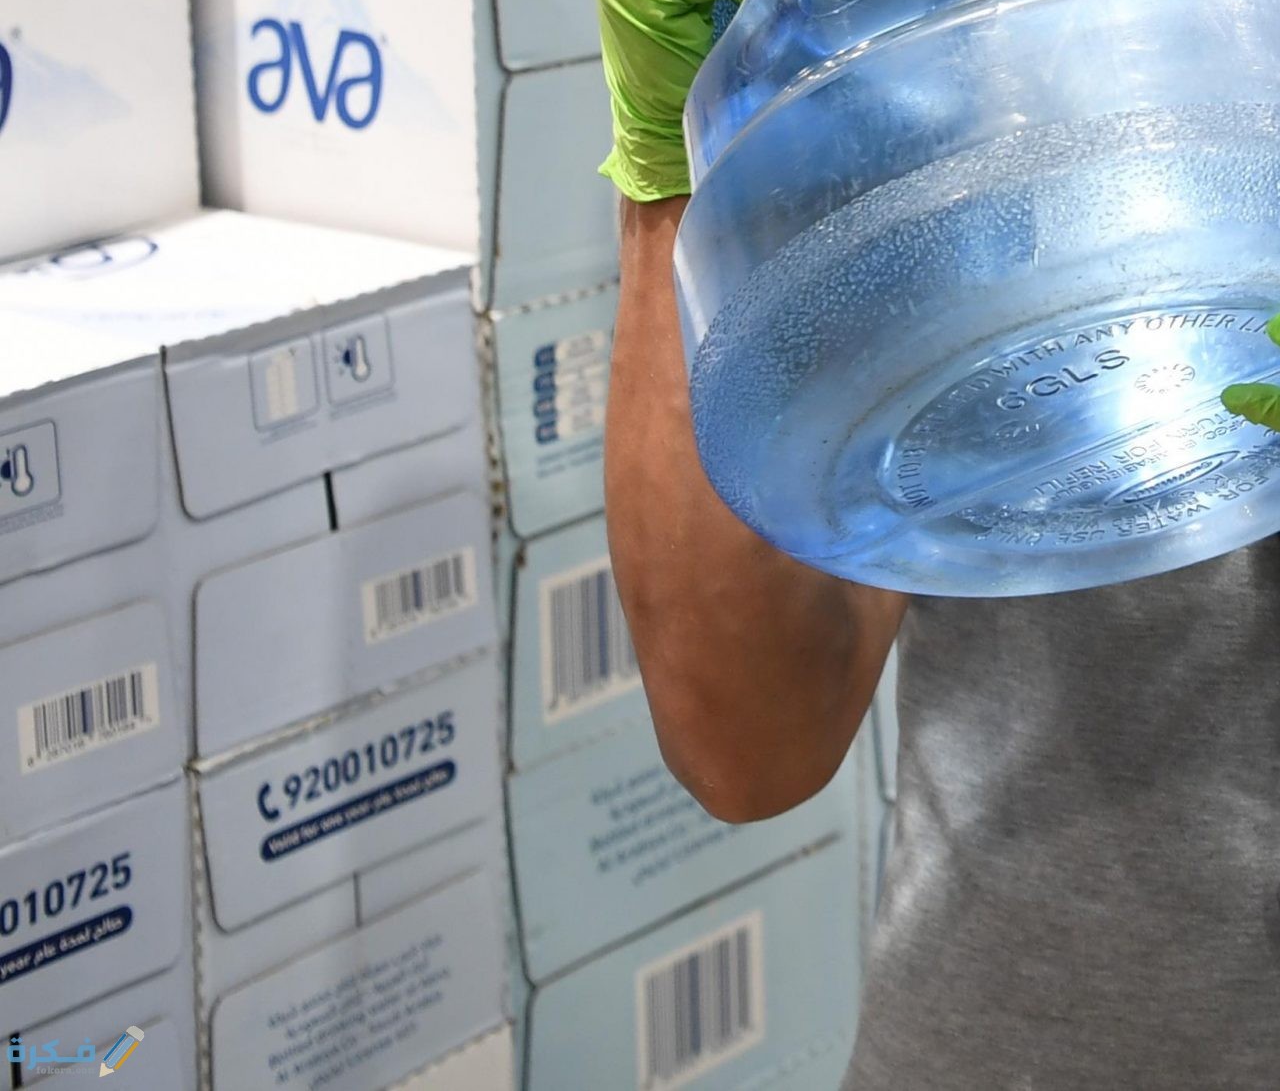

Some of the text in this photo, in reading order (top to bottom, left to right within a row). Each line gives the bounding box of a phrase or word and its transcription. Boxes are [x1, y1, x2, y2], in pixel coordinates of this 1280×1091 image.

[991, 341, 1065, 379] WITH
[1073, 320, 1136, 347] ANY
[1145, 311, 1236, 332] OTHER
[283, 710, 455, 809] 920010725
